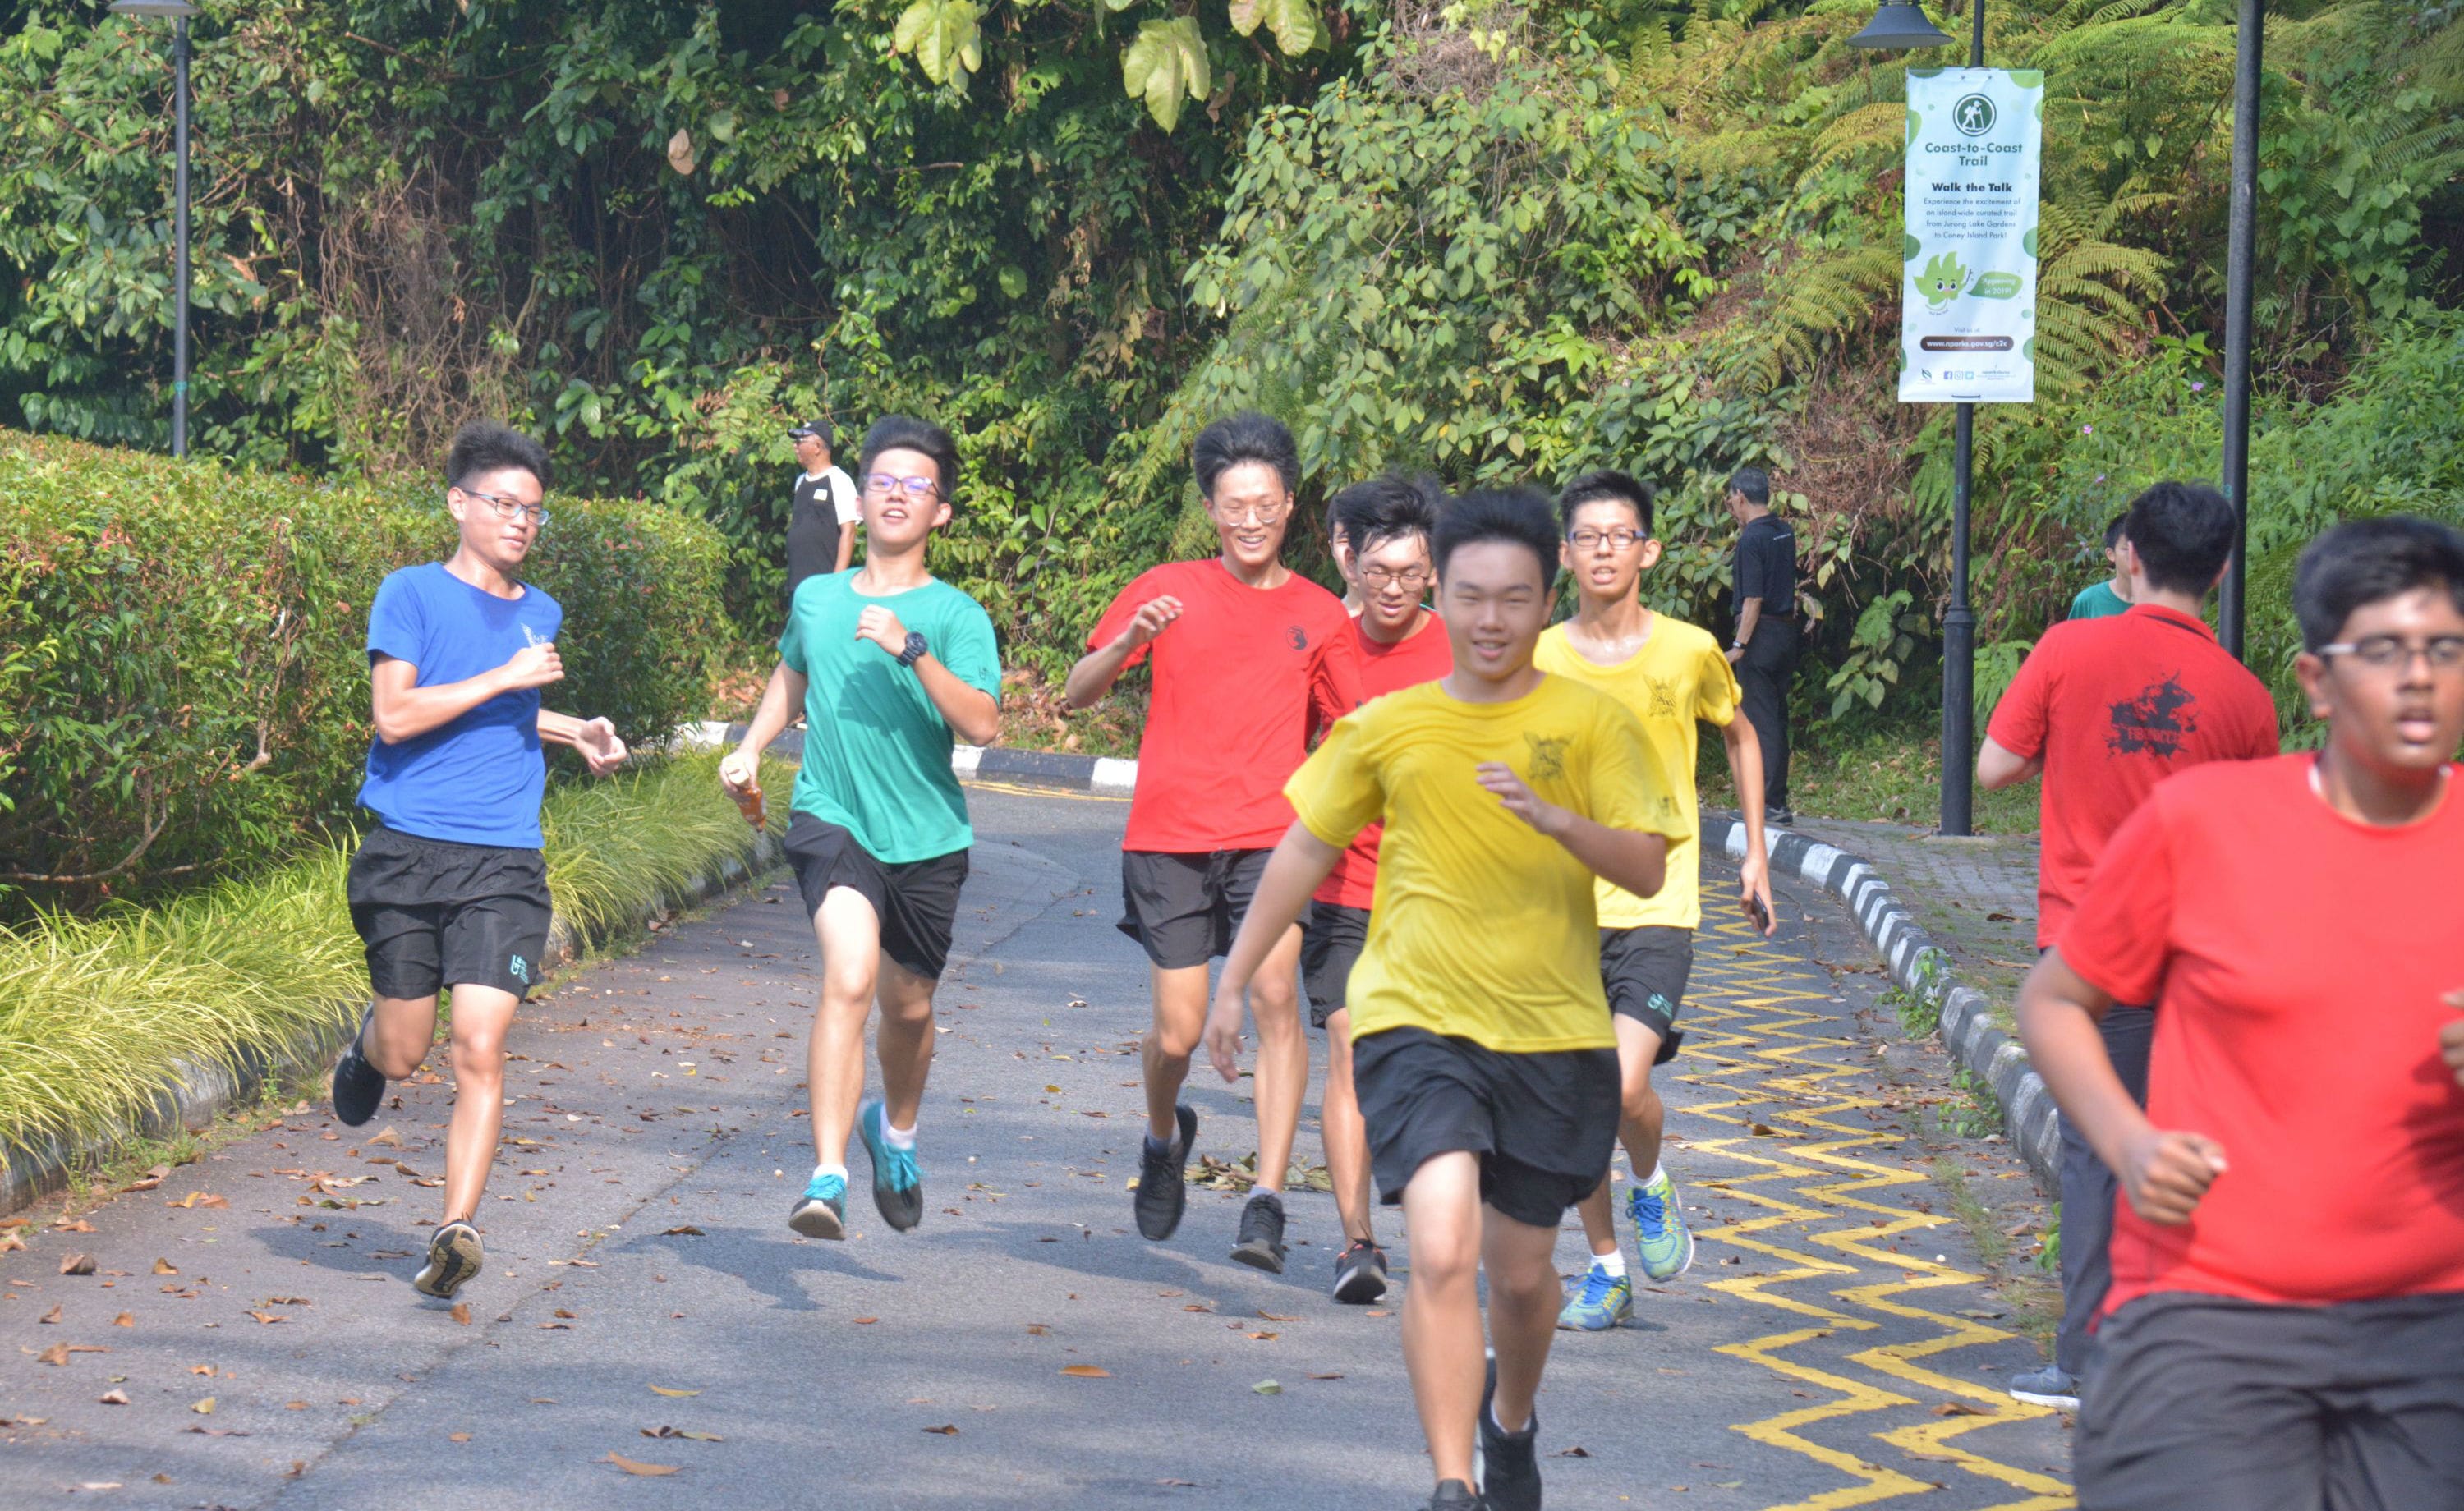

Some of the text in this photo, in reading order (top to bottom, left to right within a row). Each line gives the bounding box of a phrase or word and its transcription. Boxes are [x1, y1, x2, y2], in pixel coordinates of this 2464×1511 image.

[1925, 142, 2023, 154] Coast-to-Coast
[1959, 155, 1988, 166] Trail
[1932, 182, 2013, 192] Walk the Talk
[1924, 197, 1961, 205] Experience
[1926, 219, 1942, 227] from
[1943, 220, 1967, 229] Jurong
[1942, 232, 1965, 240] Coney
